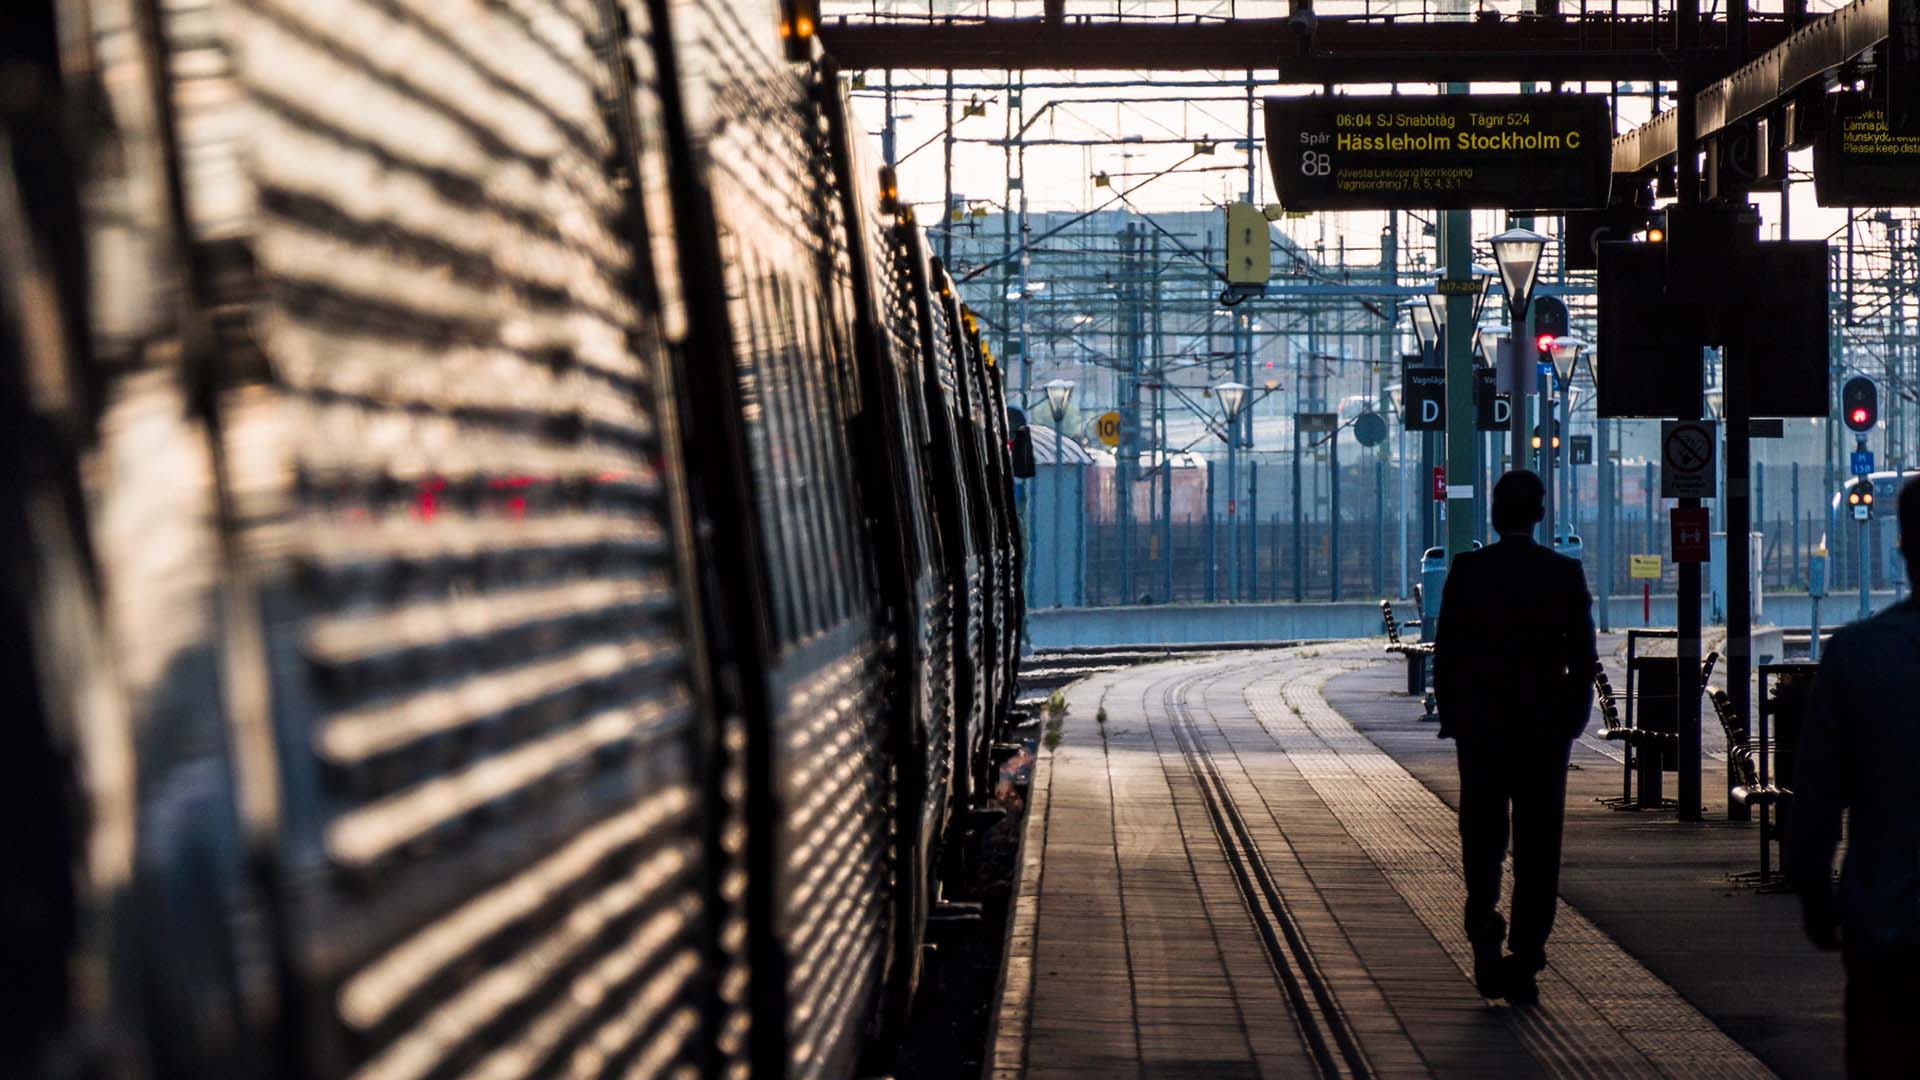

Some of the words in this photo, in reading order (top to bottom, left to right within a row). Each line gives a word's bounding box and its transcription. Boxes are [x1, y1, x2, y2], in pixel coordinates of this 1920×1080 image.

[1336, 113, 1372, 127] 06:04
[1376, 113, 1393, 127] SJ
[1396, 112, 1456, 129] Snabbtåg
[1469, 112, 1505, 128] Tågnr
[1506, 113, 1531, 126] 524
[1300, 131, 1332, 146] Spår
[1336, 132, 1451, 151] Hässleholm
[1457, 131, 1561, 150] Stockholm
[1566, 131, 1581, 149] C
[1844, 143, 1874, 153] Please
[1876, 143, 1899, 155] keep
[1301, 150, 1332, 176] 8B
[1336, 168, 1374, 178] Alvesta
[1420, 168, 1473, 180] Norrköping
[1422, 399, 1439, 423] D
[1494, 399, 1511, 423] D
